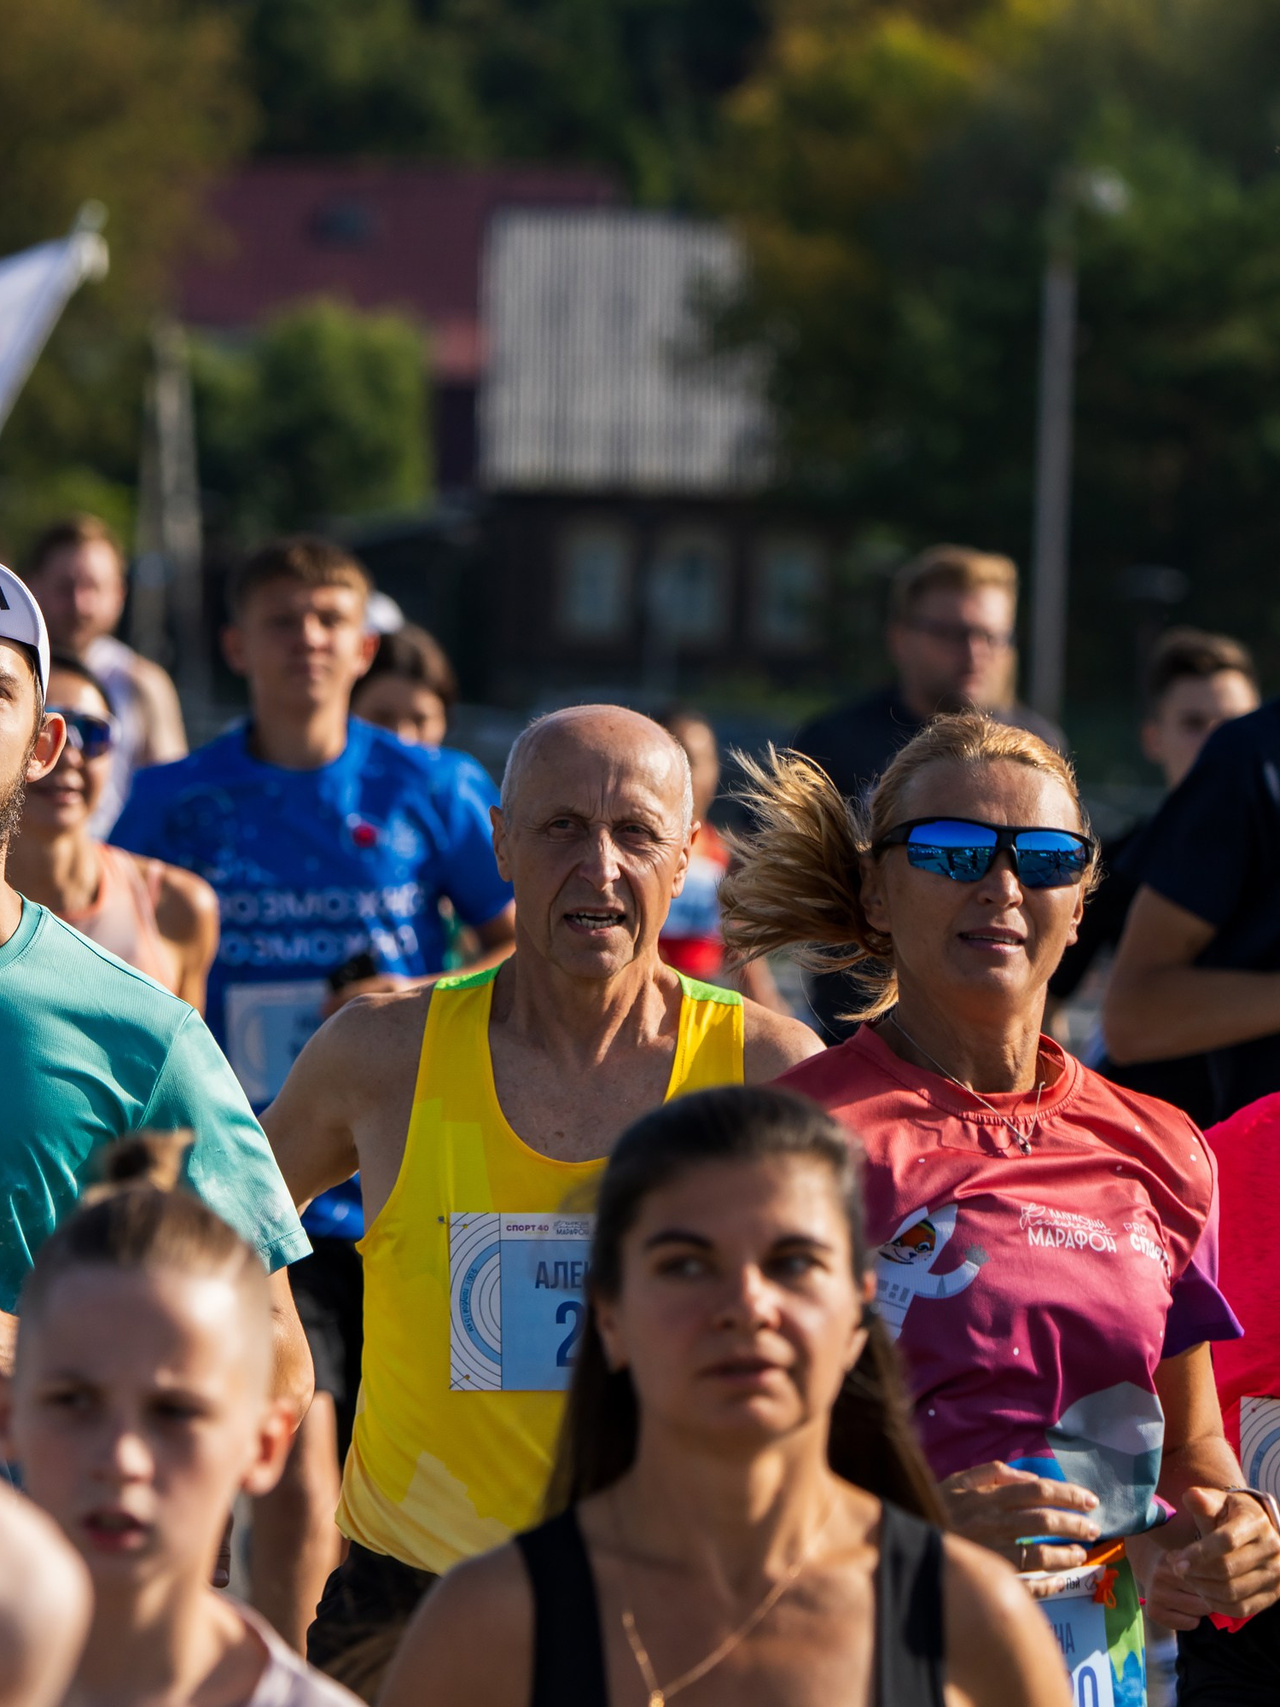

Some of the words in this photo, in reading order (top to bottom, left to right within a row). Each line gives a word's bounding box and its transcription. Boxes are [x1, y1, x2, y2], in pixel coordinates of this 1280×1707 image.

[1028, 1226, 1117, 1254] МАРАФОН
[1122, 1222, 1147, 1237] PRO
[1051, 1622, 1076, 1654] НА
